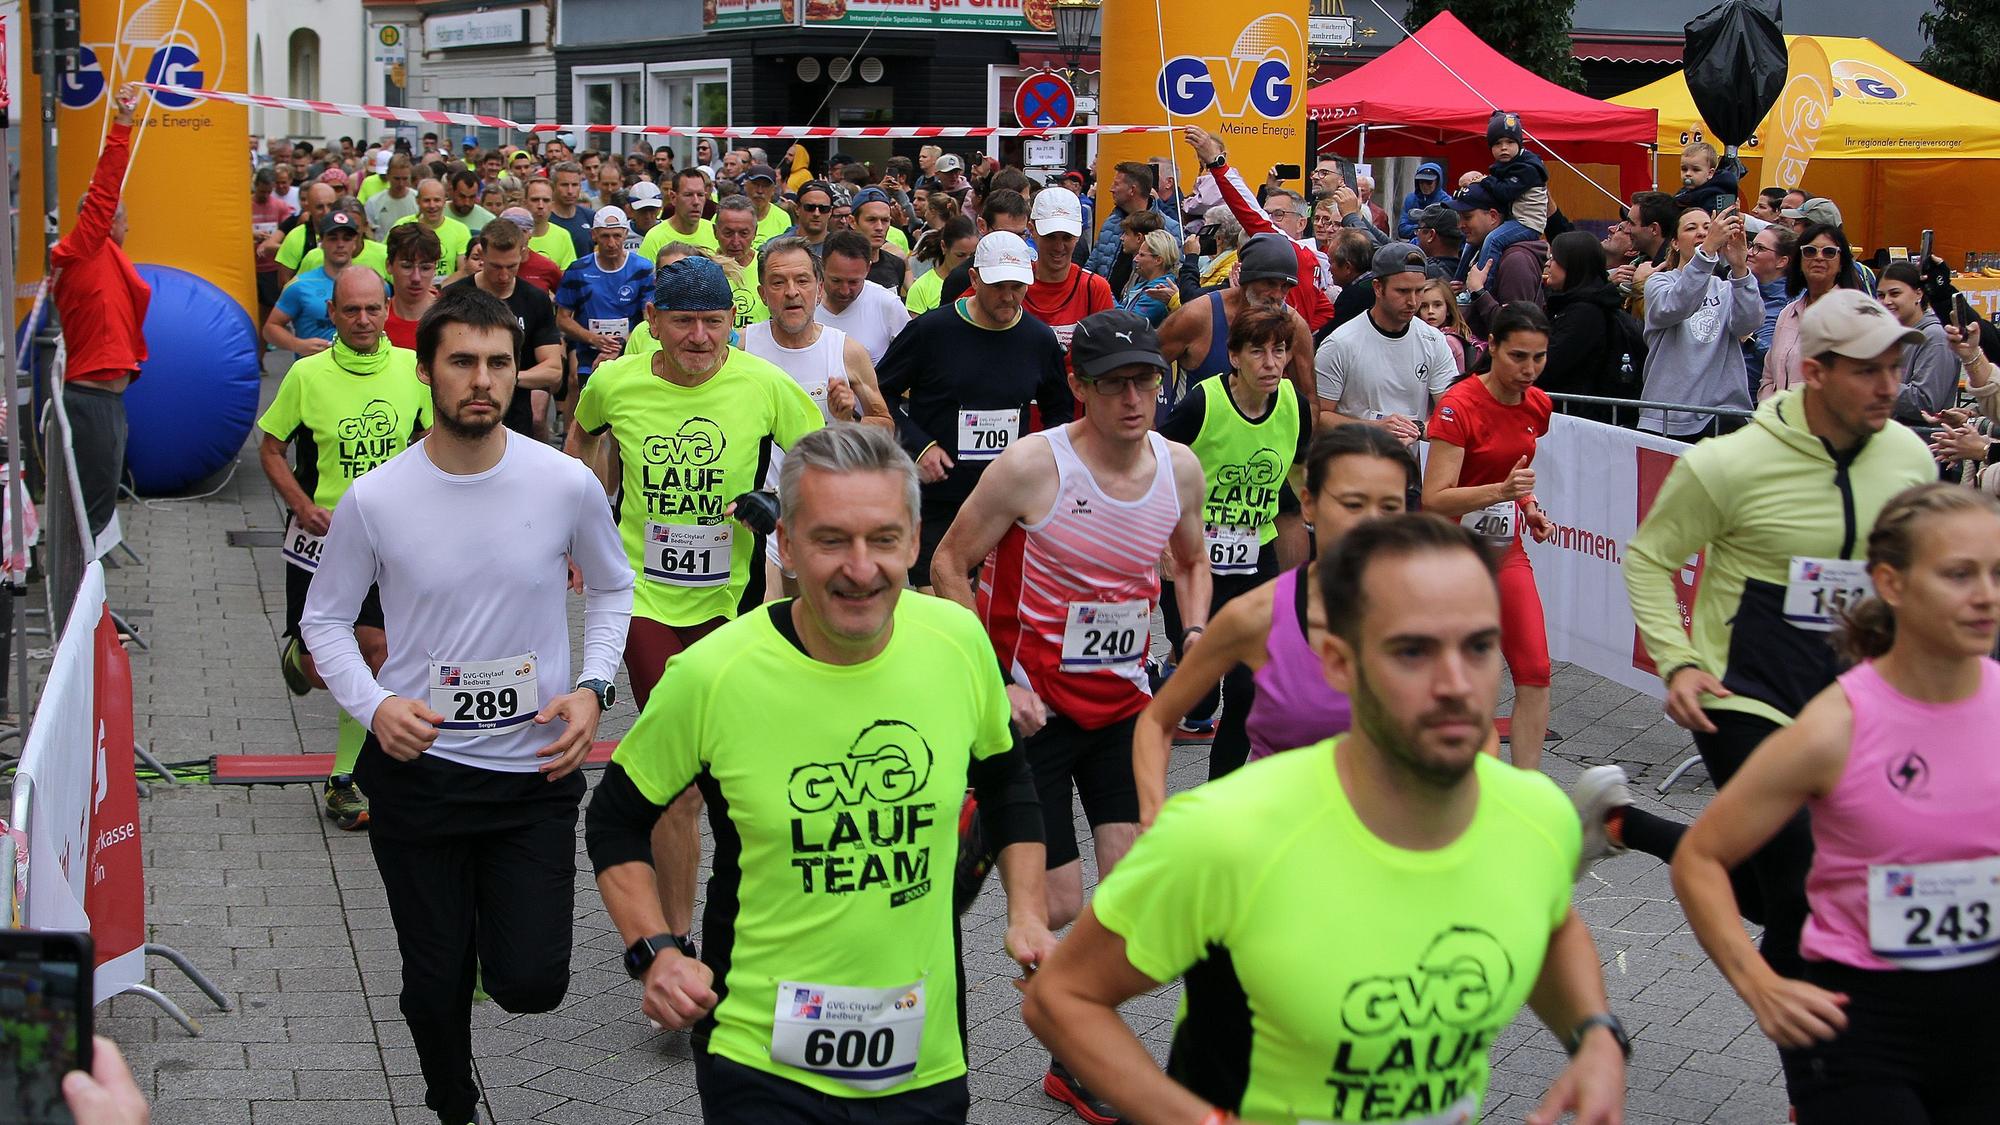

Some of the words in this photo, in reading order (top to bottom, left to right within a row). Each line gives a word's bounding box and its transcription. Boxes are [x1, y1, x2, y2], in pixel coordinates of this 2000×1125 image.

[849, 15, 892, 23] Internationale
[893, 16, 932, 24] Spezialitäten
[940, 18, 976, 26] Lieferservice
[1156, 54, 1293, 120] GVG
[1220, 122, 1258, 135] Meine
[1262, 122, 1297, 139] Energie.
[1845, 136, 1856, 146] Ihr
[1857, 137, 1897, 149] regionaler
[1898, 137, 1962, 150] Energieversorger
[338, 416, 390, 440] GVG
[972, 429, 1009, 449] 709
[339, 438, 397, 461] LAUF
[643, 435, 714, 466] GVG
[339, 460, 388, 479] TEA
[642, 465, 725, 492] LAUF
[1217, 464, 1273, 486] GVG
[642, 491, 723, 516] TEAM
[1208, 486, 1278, 509] LAUF
[1206, 505, 1270, 526] TEAM
[1474, 515, 1509, 536] 406
[670, 532, 705, 541] GVG-Citylauf
[660, 547, 711, 574] 641
[1210, 543, 1248, 564] 612
[1082, 629, 1135, 656] 240
[463, 670, 504, 679] GVG-Citylauf
[453, 688, 518, 721] 289
[788, 755, 916, 813] GVG
[791, 803, 936, 853] LAUF
[791, 847, 931, 893] TEAM
[1905, 901, 1990, 945] 243
[826, 1001, 883, 1012] GVG-Citylauf
[1341, 970, 1491, 1037] GVG
[825, 1011, 863, 1022] Bedburg
[804, 1028, 894, 1068] 600
[1333, 1031, 1484, 1077] LAUF
